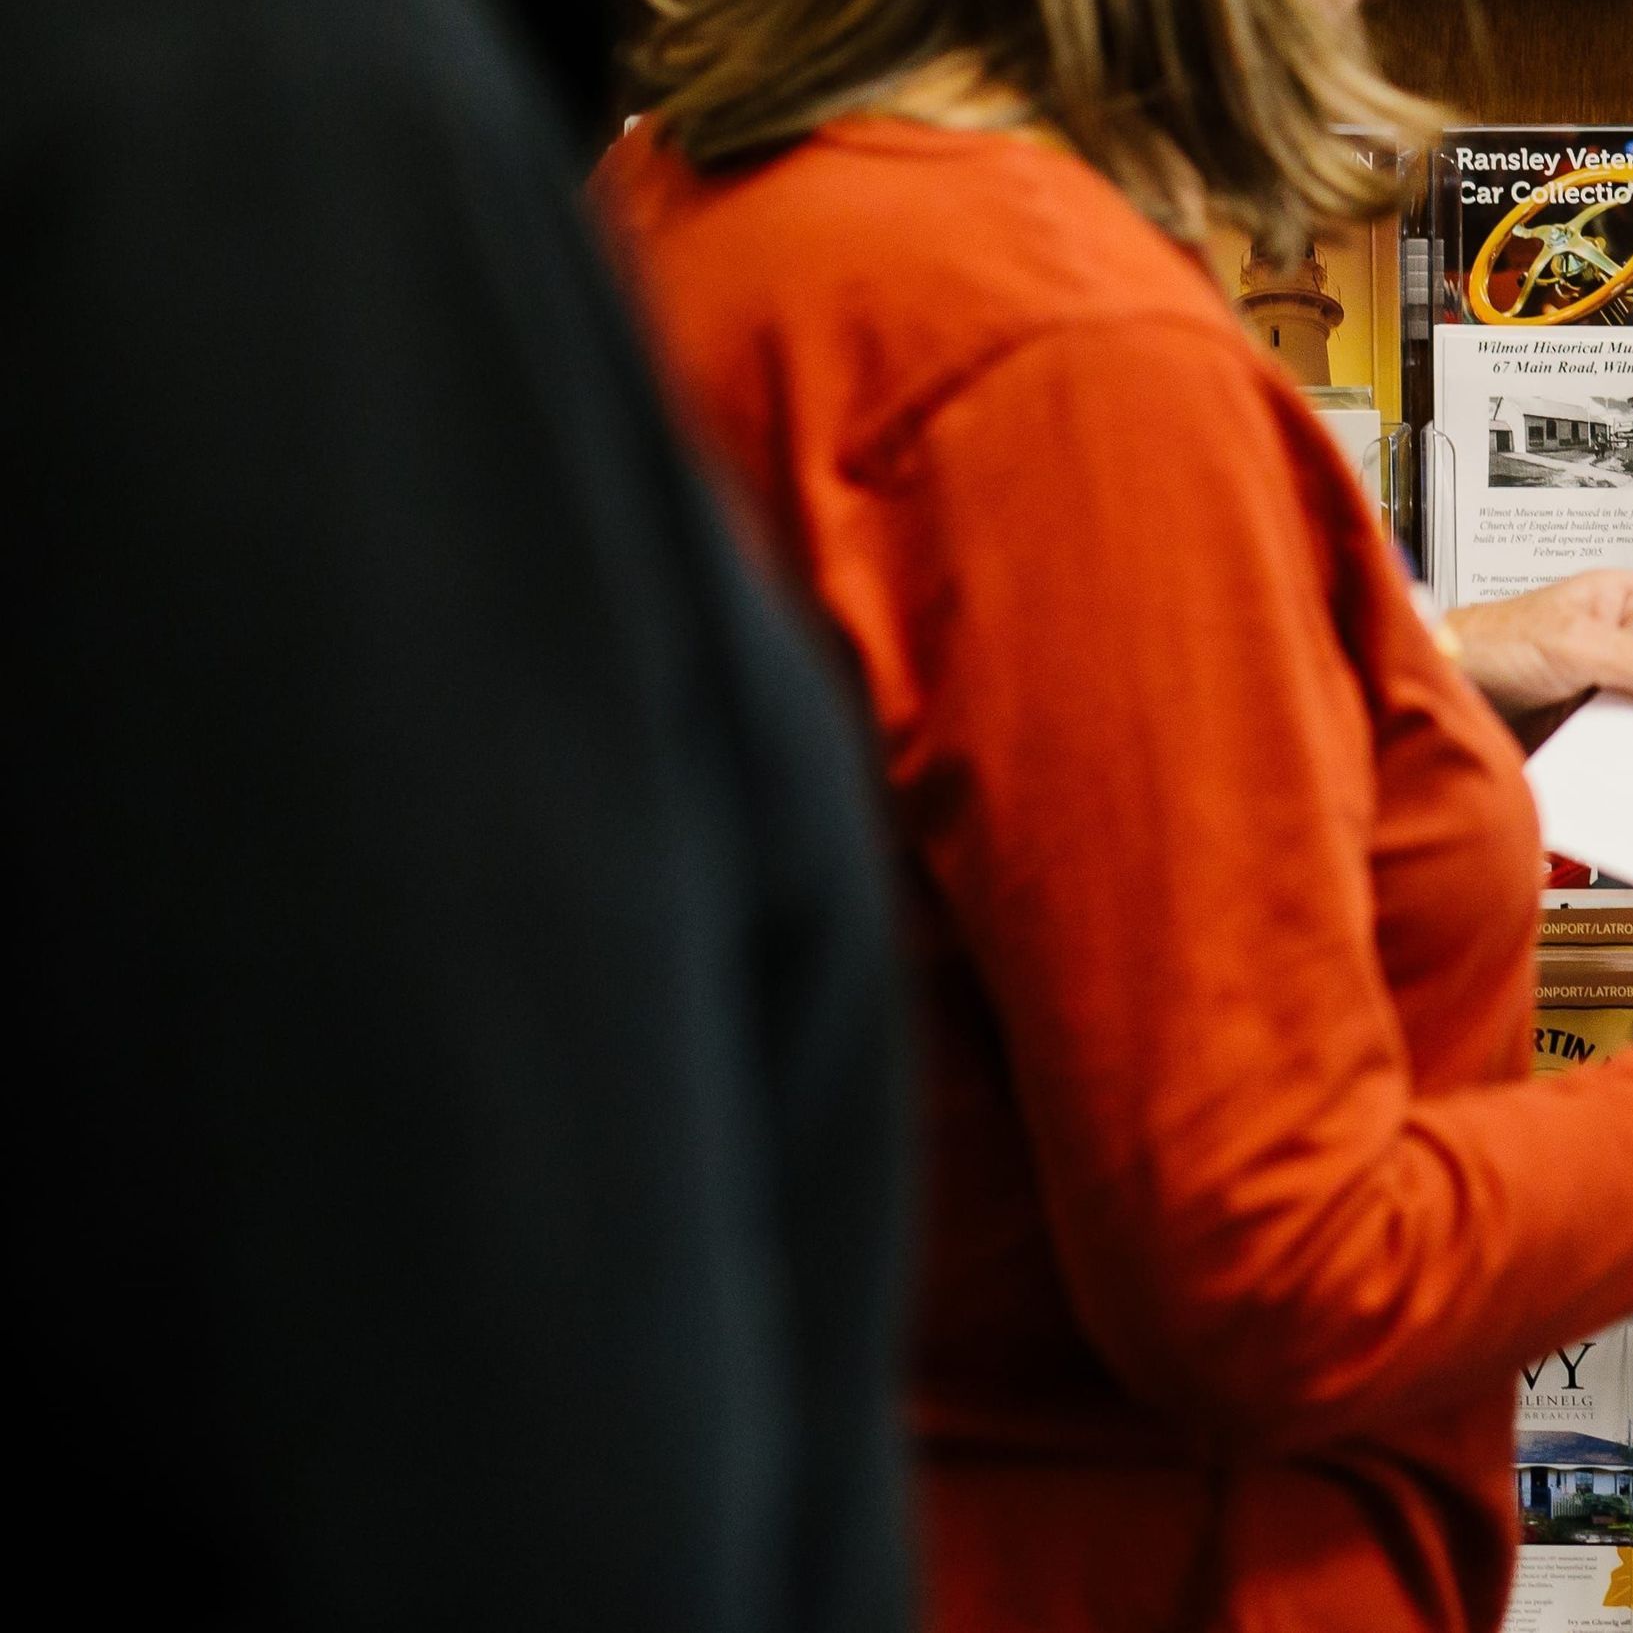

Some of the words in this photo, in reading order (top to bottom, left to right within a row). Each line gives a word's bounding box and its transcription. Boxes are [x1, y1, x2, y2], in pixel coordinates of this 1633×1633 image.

[1460, 181, 1502, 204] Car
[1477, 340, 1529, 354] Wilmot
[1533, 341, 1604, 354] Historical
